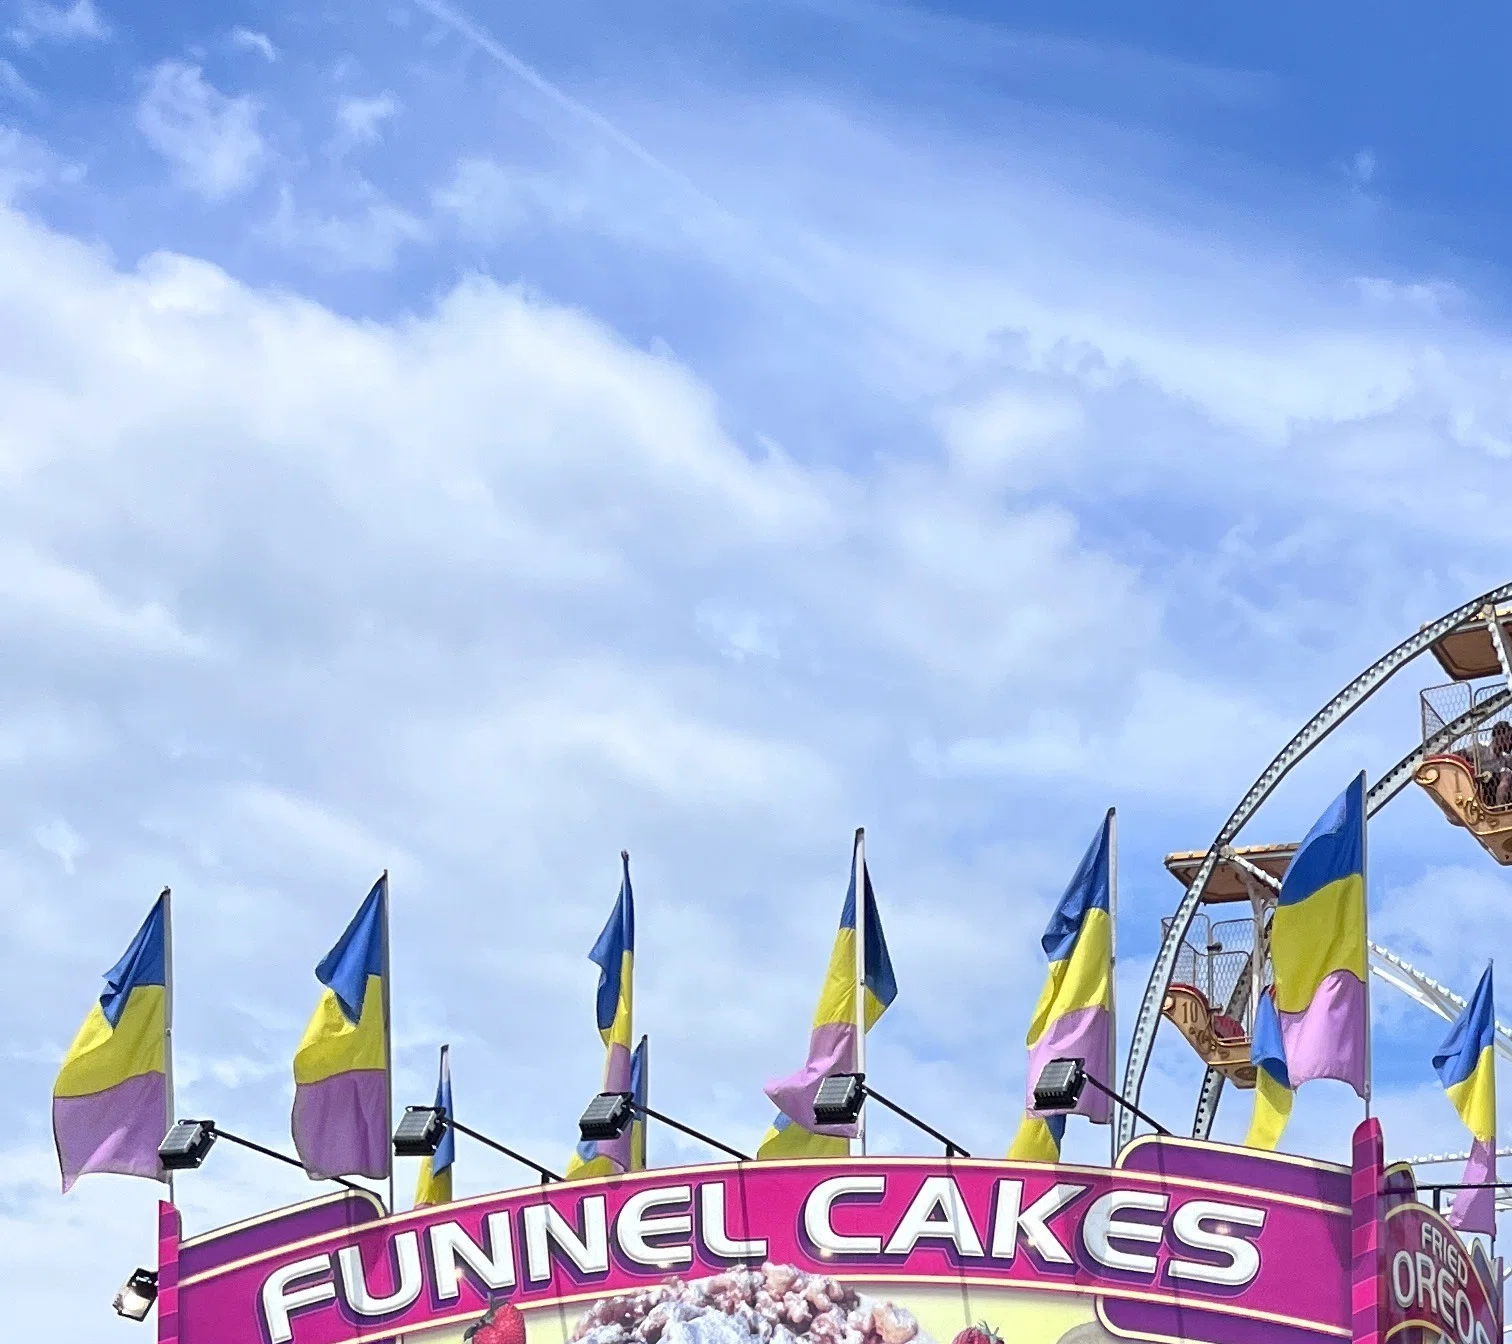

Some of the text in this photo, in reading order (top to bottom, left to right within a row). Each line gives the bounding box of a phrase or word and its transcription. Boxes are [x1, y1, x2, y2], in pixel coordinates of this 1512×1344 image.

[1181, 1000, 1199, 1024] 10
[261, 1174, 1264, 1344] FUNNEL CAKES
[1421, 1221, 1469, 1289] FRIED
